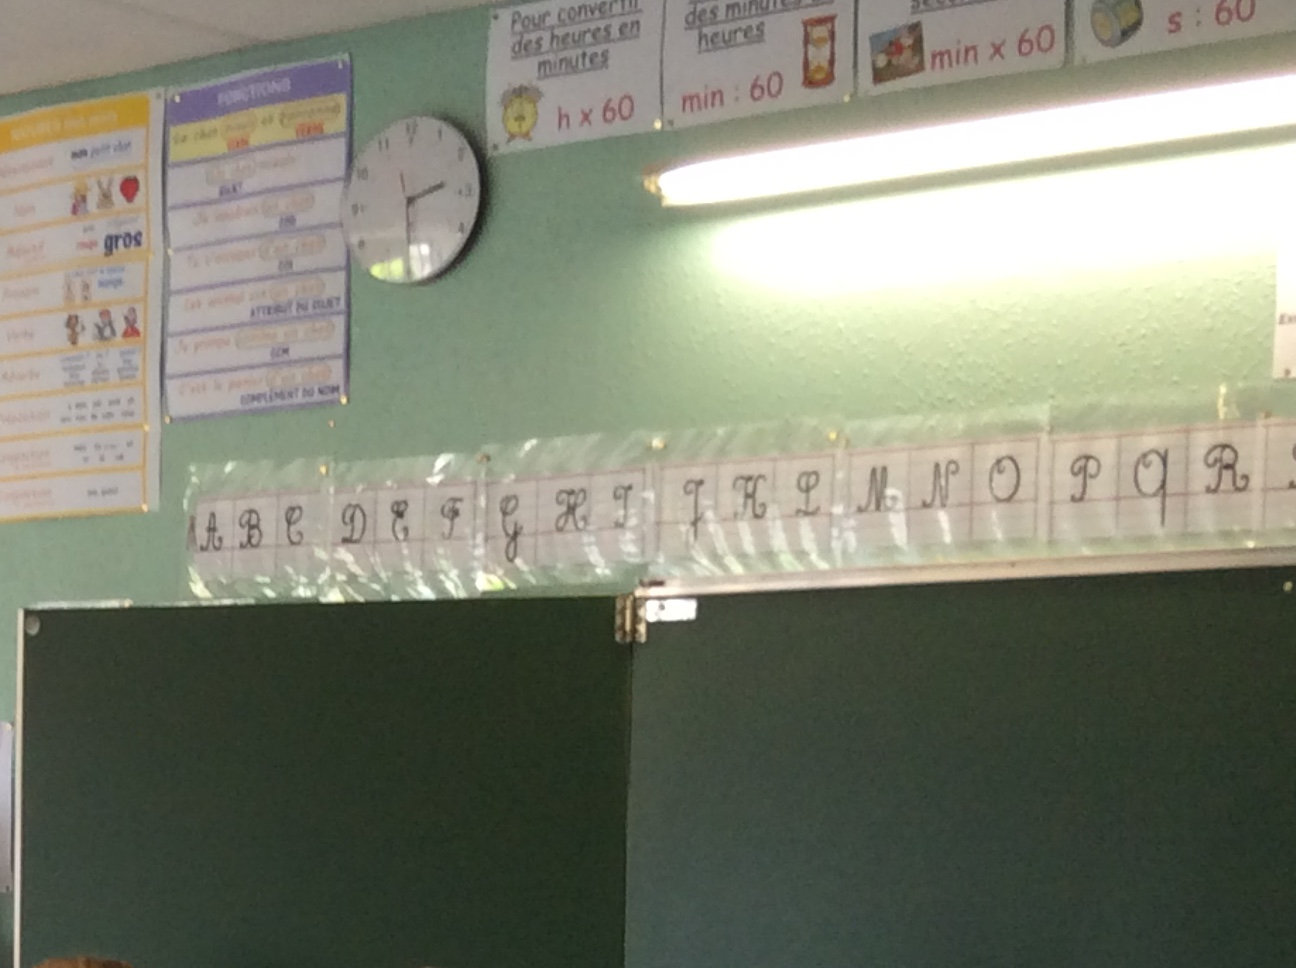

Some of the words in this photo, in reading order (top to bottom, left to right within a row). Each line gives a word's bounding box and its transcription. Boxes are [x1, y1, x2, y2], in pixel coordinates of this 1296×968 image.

[511, 10, 551, 31] Pour
[685, 3, 718, 25] des
[511, 35, 543, 55] des
[550, 23, 612, 48] heures
[619, 20, 640, 36] en
[698, 21, 764, 48] heures
[931, 40, 978, 72] min
[1017, 24, 1055, 57] 60
[538, 50, 609, 74] minutes
[682, 86, 724, 114] min
[749, 71, 784, 100] 60
[558, 107, 570, 130] h
[603, 95, 635, 121] 60
[104, 231, 143, 257] gros
[200, 511, 223, 551] A
[238, 508, 263, 549] B
[285, 505, 303, 545] C
[341, 503, 366, 544] D
[391, 500, 409, 541] E
[441, 497, 464, 541] F
[555, 488, 587, 532] H
[732, 474, 767, 519] K
[796, 470, 821, 515] L
[922, 460, 960, 508] N
[989, 455, 1021, 502] O
[1070, 454, 1101, 502] P
[1134, 448, 1168, 526] Q
[1204, 443, 1249, 493] R
